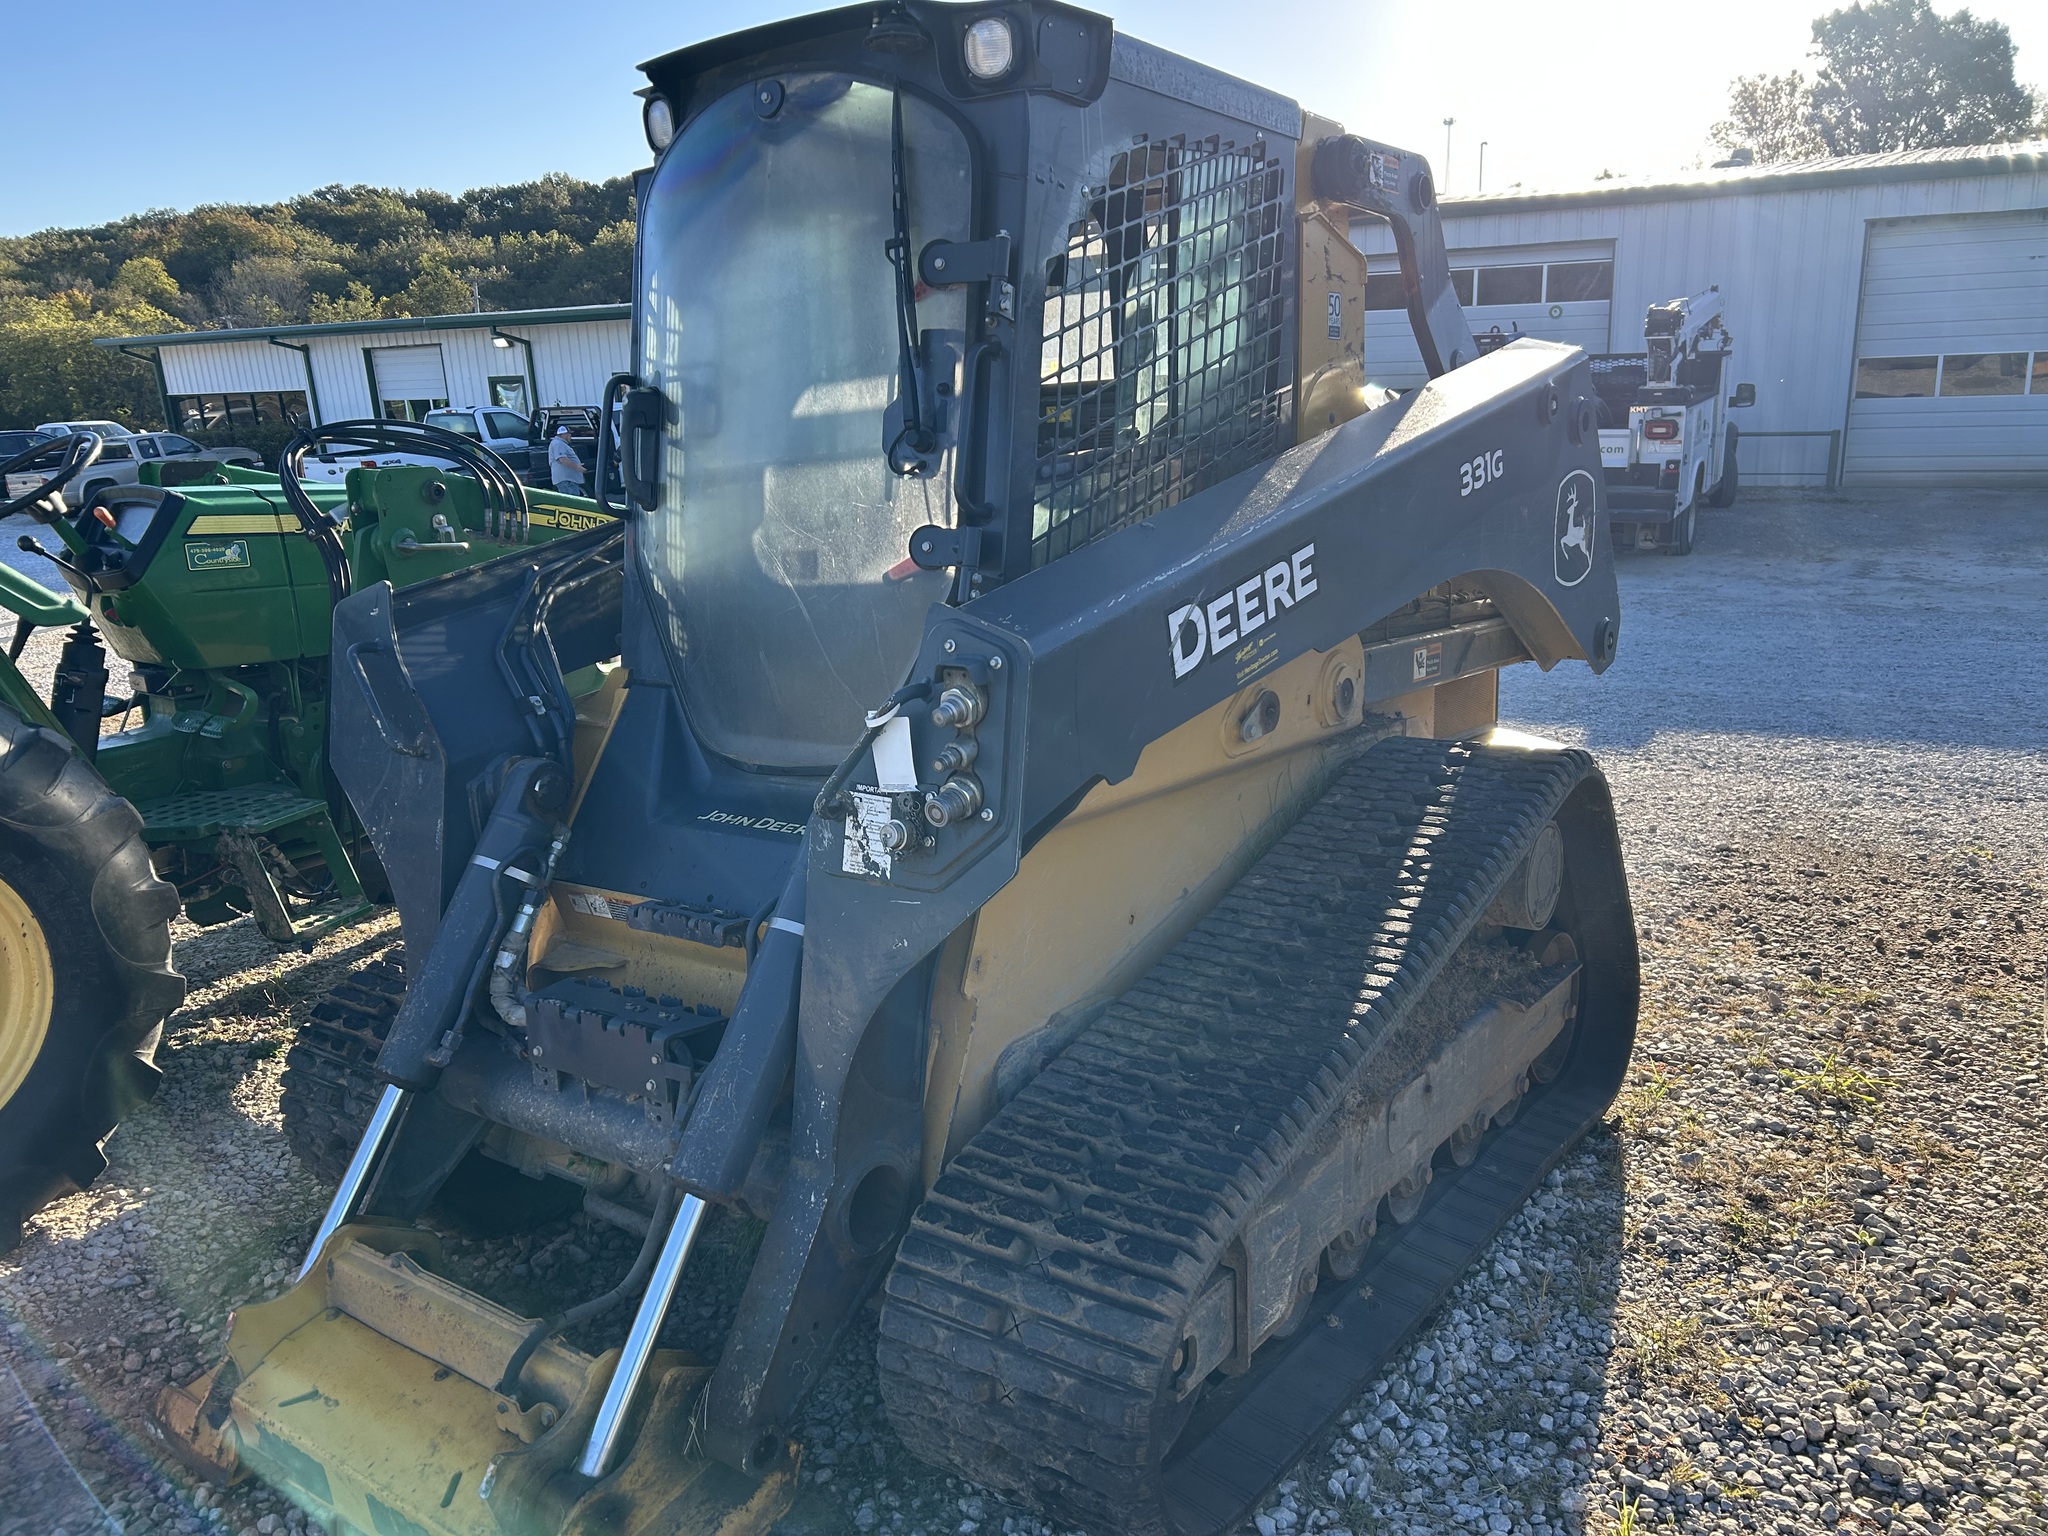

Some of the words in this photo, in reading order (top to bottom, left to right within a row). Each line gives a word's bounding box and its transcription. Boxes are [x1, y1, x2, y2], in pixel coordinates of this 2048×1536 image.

[1328, 294, 1341, 317] 50
[1460, 449, 1504, 497] 331G
[548, 509, 595, 530] JOHN
[1168, 542, 1318, 680] DEERE
[855, 783, 888, 796] IMPORTA
[697, 809, 757, 828] JOHN
[752, 817, 807, 837] DEER
